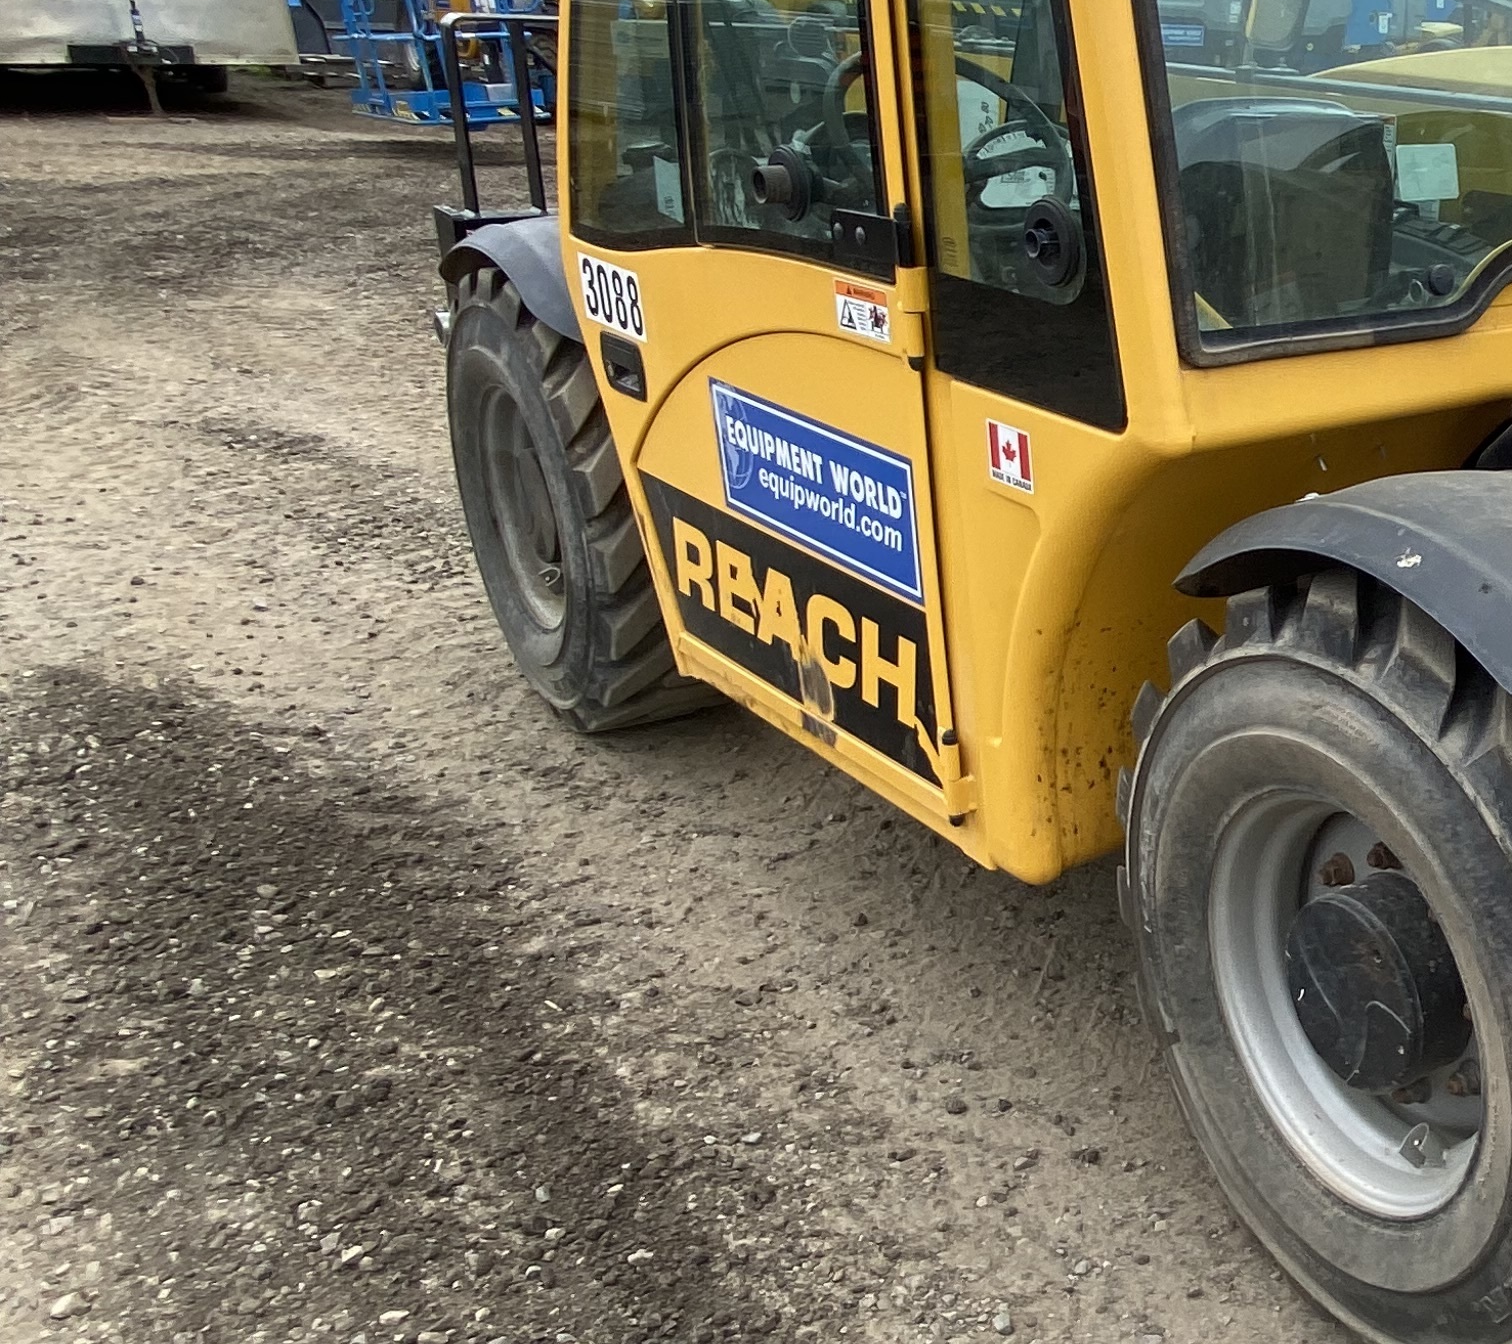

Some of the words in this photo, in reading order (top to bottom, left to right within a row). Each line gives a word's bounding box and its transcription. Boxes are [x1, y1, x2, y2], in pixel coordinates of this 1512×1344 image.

[582, 258, 643, 336] 3088
[725, 414, 823, 485] EQUIPMENT
[829, 460, 902, 520] WORLD
[758, 467, 902, 552] equipworld.com
[672, 516, 919, 728] REACH
